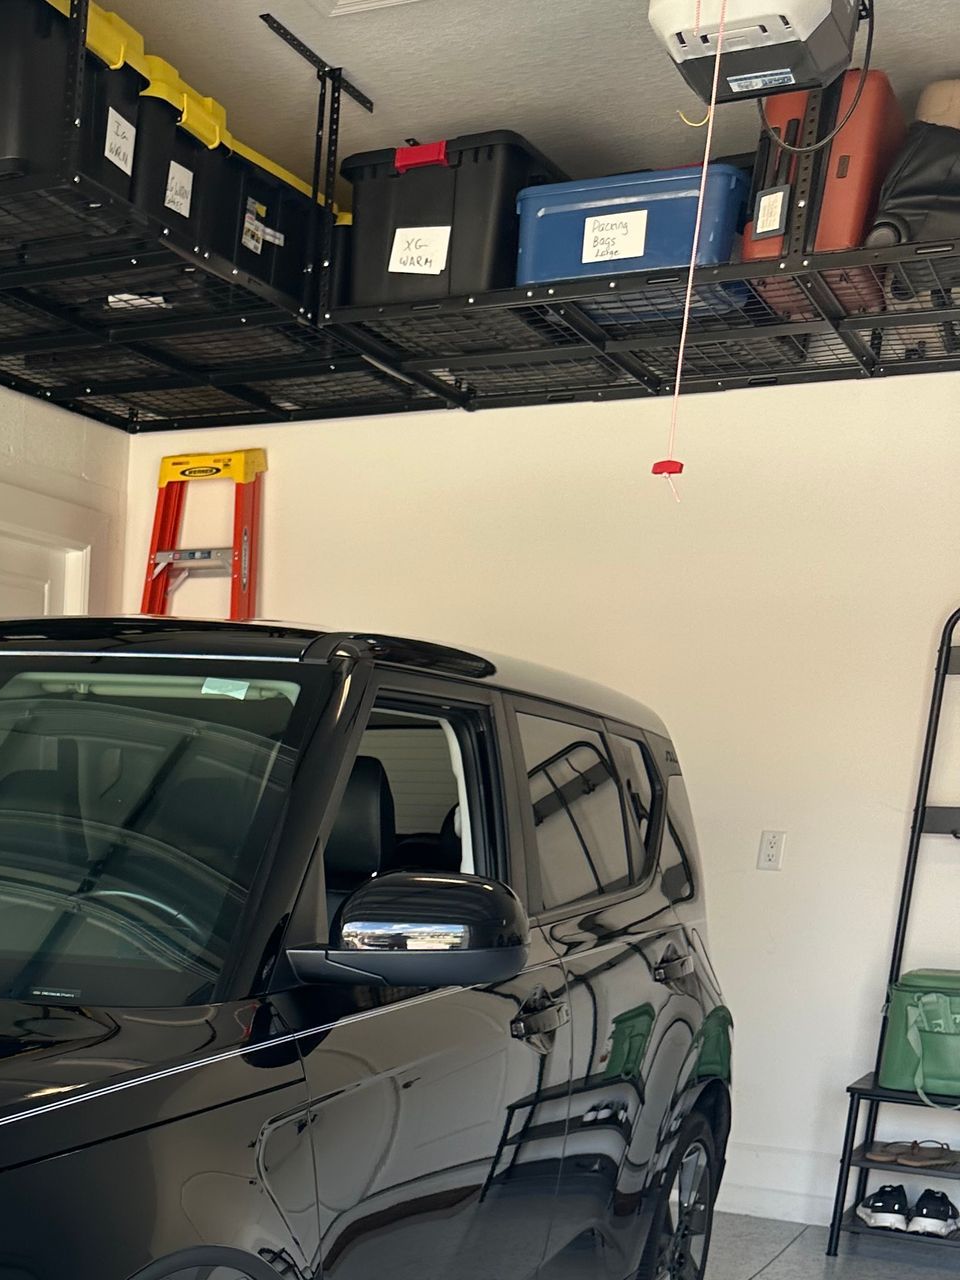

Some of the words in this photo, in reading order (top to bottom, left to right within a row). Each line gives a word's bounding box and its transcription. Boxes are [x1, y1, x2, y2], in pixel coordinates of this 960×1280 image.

[403, 238, 431, 252] XG
[592, 235, 617, 250] Bags
[399, 255, 433, 269] WARM
